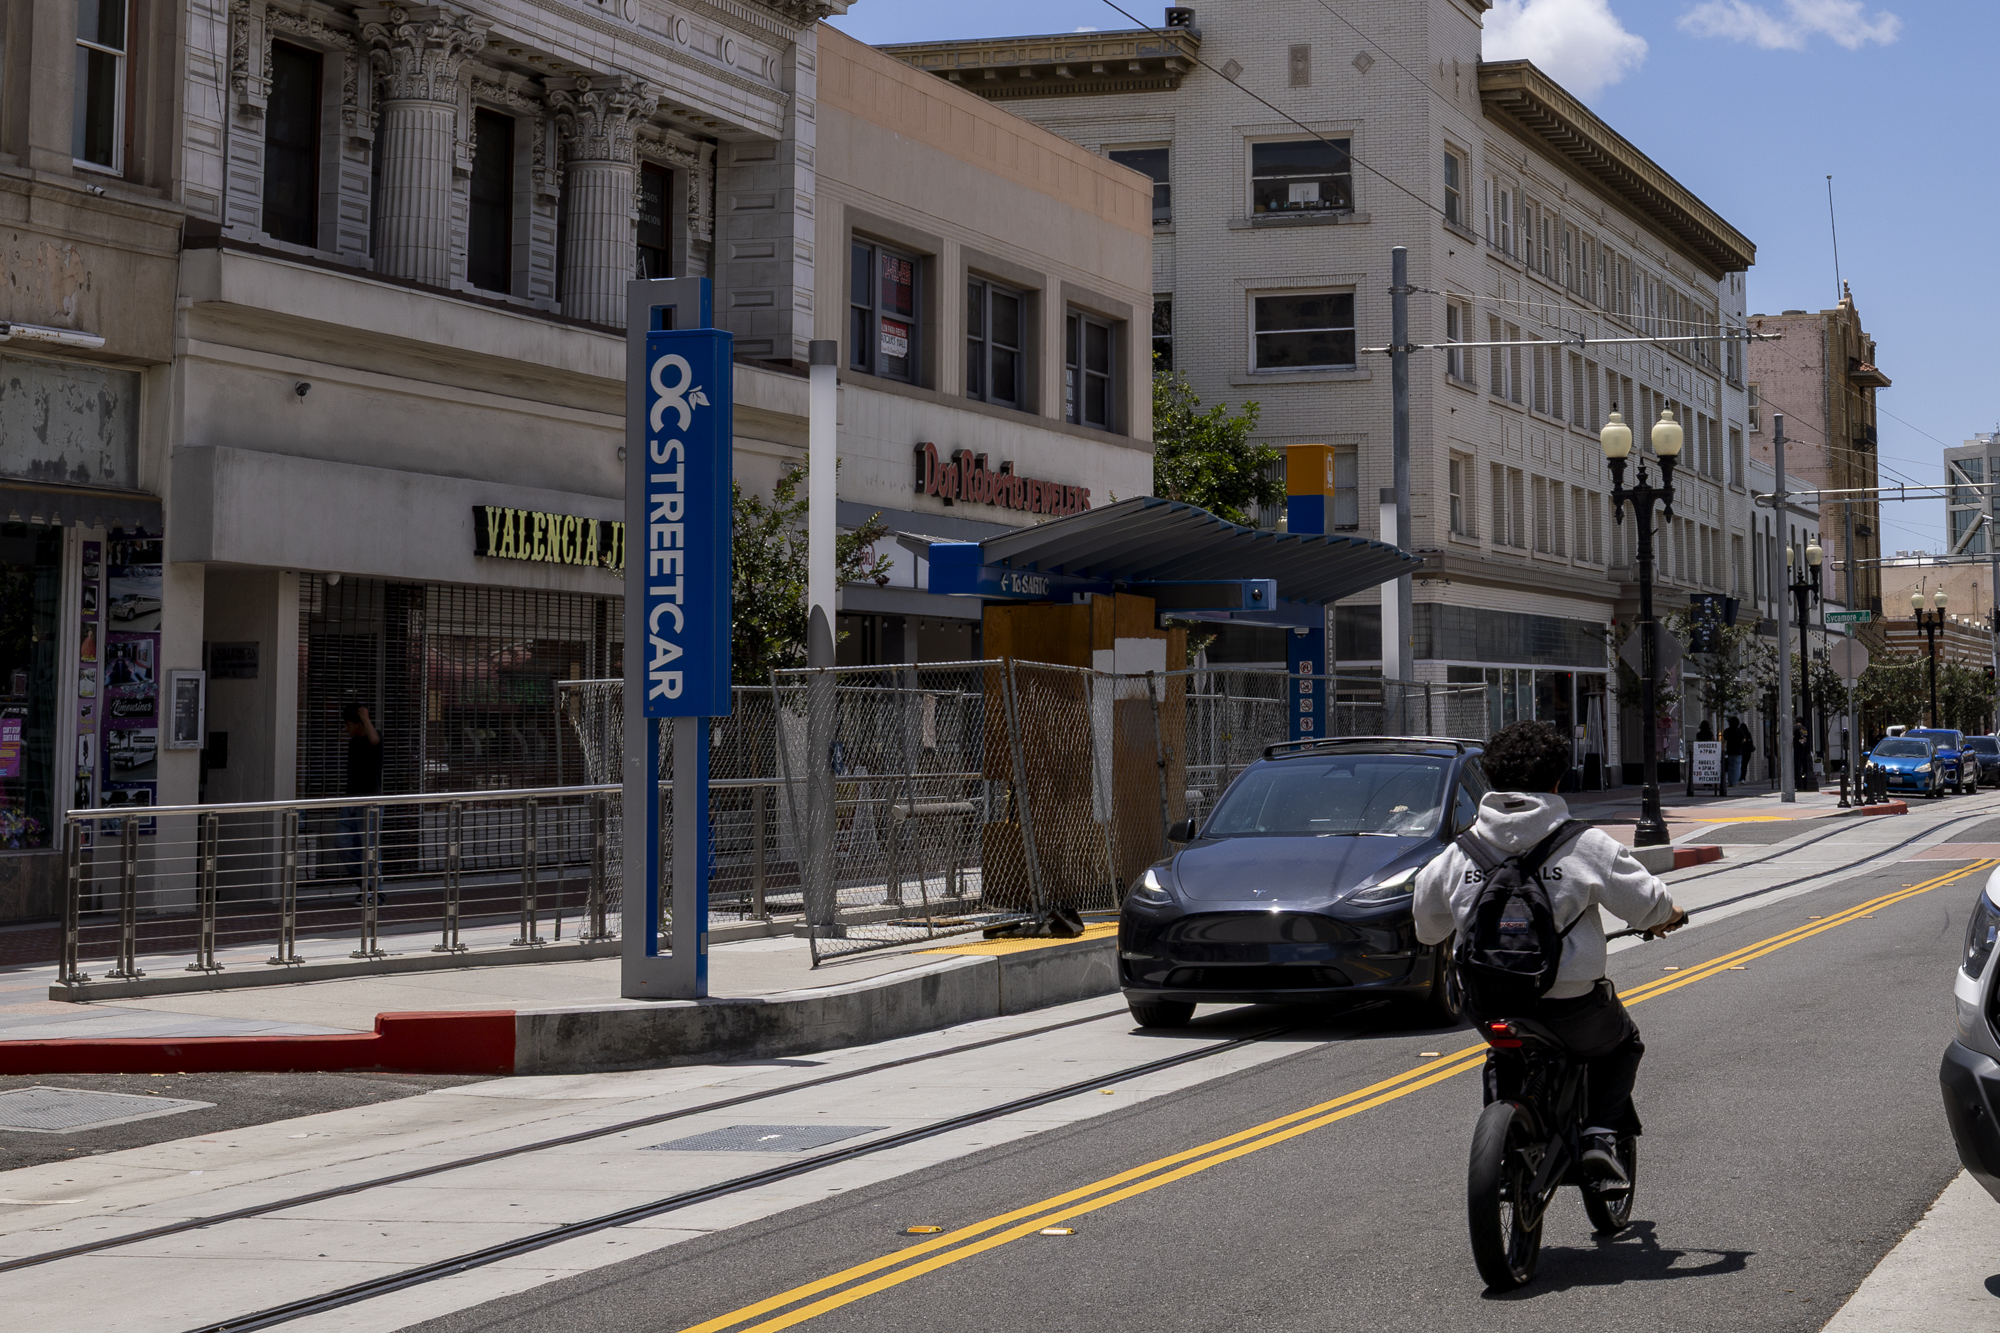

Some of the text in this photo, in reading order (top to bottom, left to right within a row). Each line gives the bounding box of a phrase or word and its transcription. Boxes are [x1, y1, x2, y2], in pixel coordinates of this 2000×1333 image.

[640, 212, 661, 226] RACION
[921, 442, 1092, 516] Don Roberto JEWELERS
[485, 505, 600, 567] VALENCIA
[648, 353, 693, 701] OC STREETCAR
[1011, 573, 1049, 596] To SARTC
[1826, 613, 1857, 623] Sycamore
[111, 699, 152, 717] Limousines
